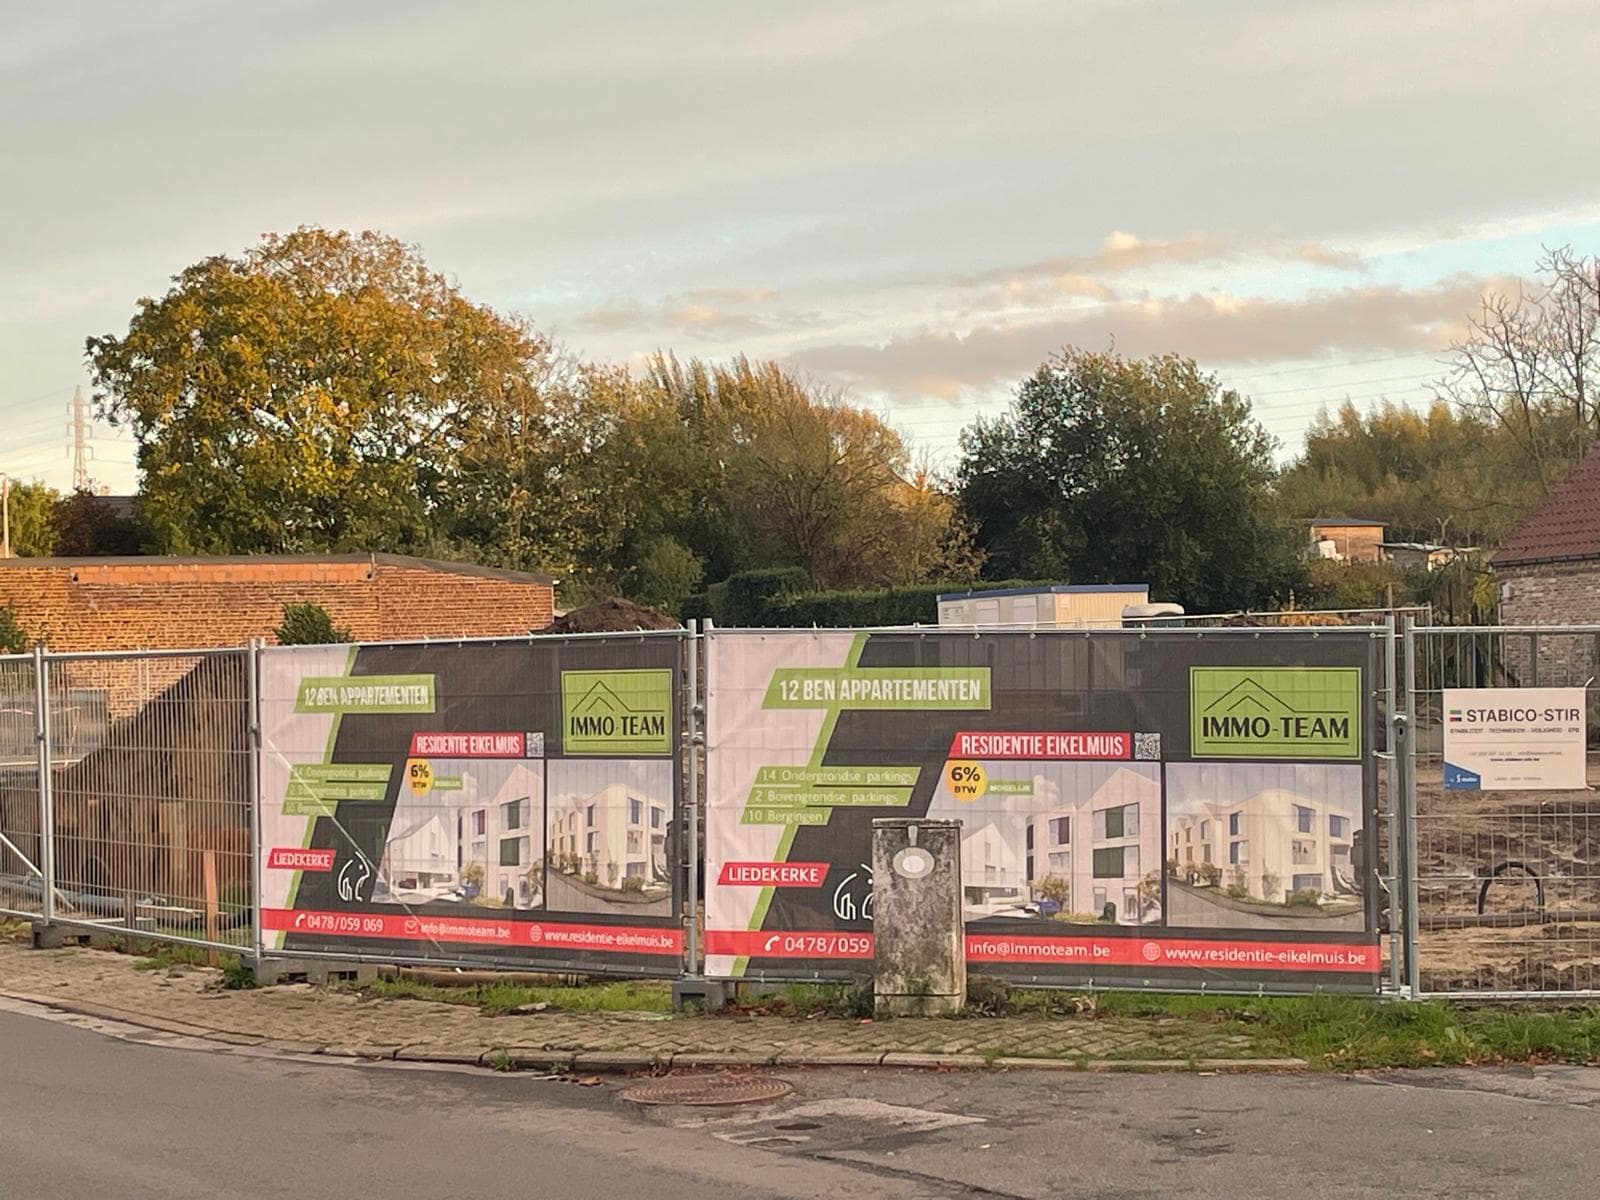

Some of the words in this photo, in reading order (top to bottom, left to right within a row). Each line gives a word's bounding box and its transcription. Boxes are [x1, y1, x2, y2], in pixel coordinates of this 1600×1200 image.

[305, 687, 316, 706] 12
[340, 685, 429, 706] APPARTEMENTEN
[779, 679, 799, 701] 12
[803, 679, 835, 701] BEN
[840, 679, 981, 701] APPARTEMENTEN
[1466, 708, 1580, 723] STABICO-STIR
[1203, 716, 1349, 739] IMMO-TEAM
[416, 735, 468, 754] RESIDENTIE
[470, 735, 520, 754] EIKELMUIS
[961, 735, 1043, 756] RESIDENTIE
[1046, 735, 1124, 756] EIKELMUIS
[410, 764, 430, 778] 6%
[762, 770, 776, 782] 14
[781, 769, 861, 784] Ondergrondse
[867, 770, 914, 785] parkings
[951, 766, 981, 782] 6%
[755, 790, 763, 801] 2
[767, 790, 847, 804] Bovengrondse
[851, 791, 899, 804] parkings
[954, 785, 977, 794] BTW
[749, 810, 762, 822] 10
[767, 810, 823, 824] Bergingen
[273, 853, 331, 868] LIEDEKERKE
[728, 866, 820, 884] LIEDEKERKE
[307, 915, 361, 932] 0478/059
[363, 918, 384, 933] 069
[544, 930, 674, 948] www.residentie-eikelmuis.be
[784, 936, 870, 954] 0478/059
[969, 940, 1111, 958] info@immoteam.be
[1165, 946, 1367, 966] www.residentie-eikelmuis.be
